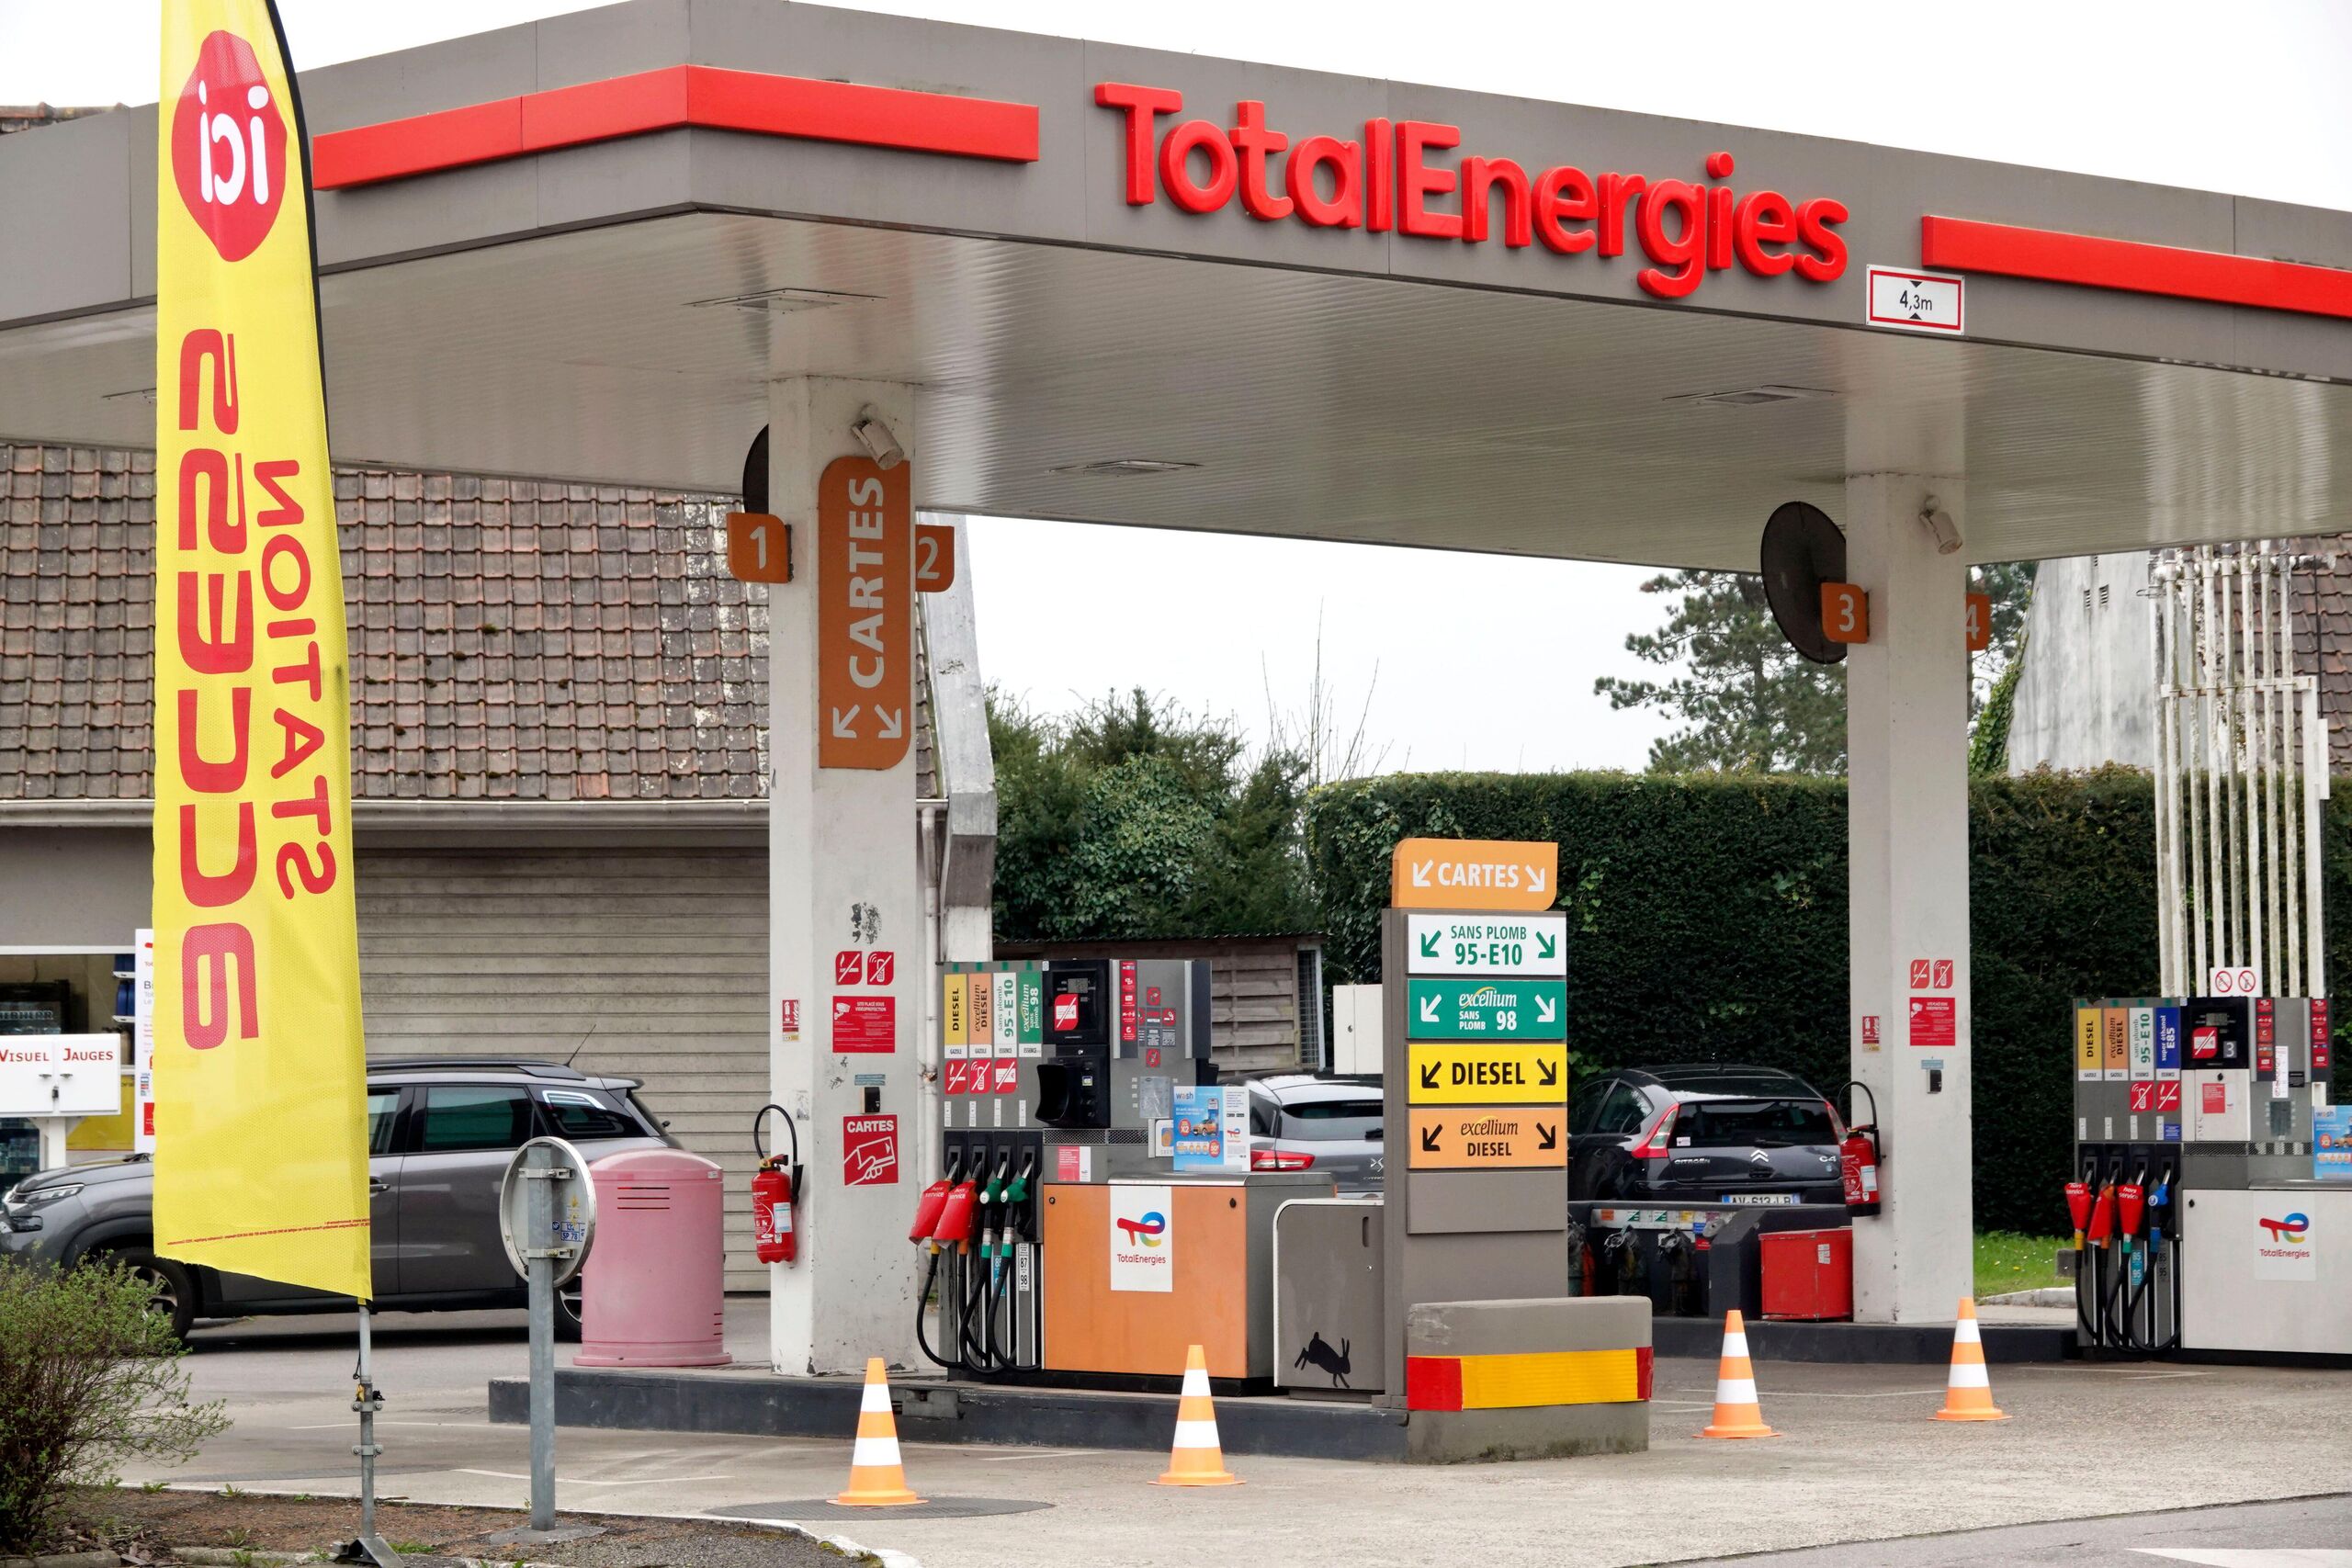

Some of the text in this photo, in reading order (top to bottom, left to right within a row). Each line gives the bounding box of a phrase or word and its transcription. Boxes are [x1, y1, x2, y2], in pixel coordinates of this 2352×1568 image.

[1093, 80, 1849, 299] TotalEnergies
[1899, 288, 1933, 313] 4,3m
[749, 525, 768, 570] 1
[917, 536, 940, 581] 2
[848, 477, 885, 689] CARTES
[1838, 593, 1856, 633] 3
[1438, 862, 1520, 888] CARTES
[1451, 925, 1527, 940] SANS PLOMB
[1454, 942, 1522, 966] 95-E10
[1030, 987, 1039, 1006] 98
[1458, 988, 1518, 1009] excellium
[1021, 984, 1030, 1032] excellium
[1459, 1010, 1480, 1021] SANS
[1459, 1021, 1487, 1031] PLOMB
[1497, 1010, 1518, 1031] 98
[2166, 1027, 2175, 1049] E85
[0, 1048, 114, 1063] VISUEL JAUGES
[2226, 1043, 2234, 1057] 3
[1452, 1061, 1526, 1086] DIESEL
[1176, 1091, 1193, 1100] wash
[847, 1120, 894, 1134] CARTES
[1461, 1117, 1519, 1136] excellium
[1466, 1142, 1512, 1156] DIESEL
[1020, 1257, 1027, 1269] 87
[1117, 1254, 1166, 1266] TotalEnergies
[2259, 1248, 2310, 1259] TotalEnergies
[1020, 1274, 1028, 1285] 98
